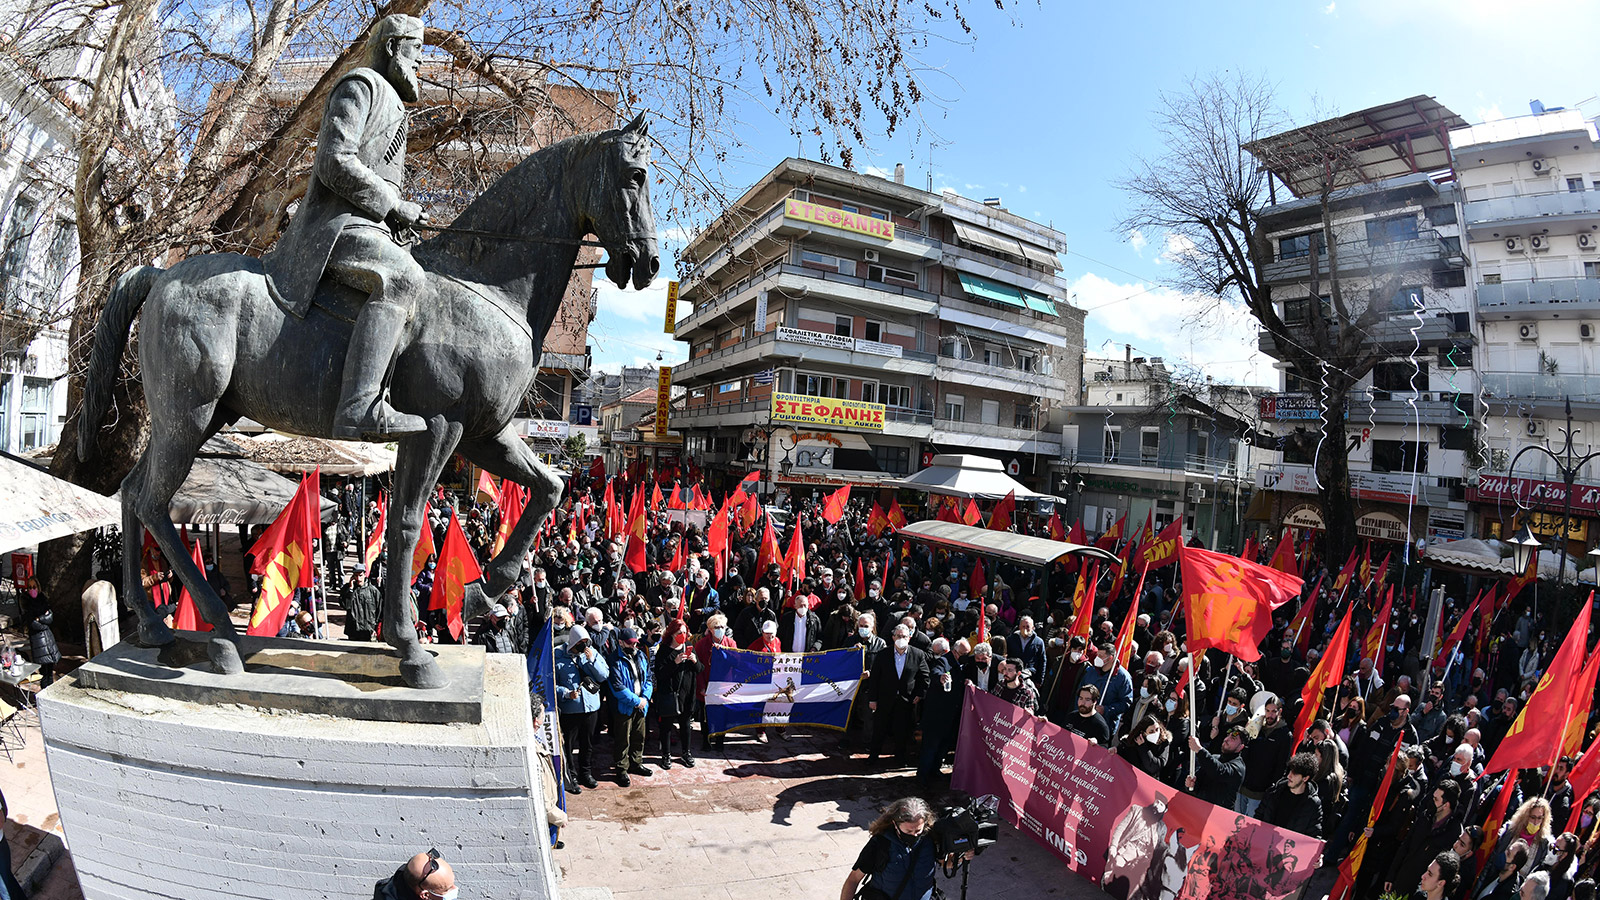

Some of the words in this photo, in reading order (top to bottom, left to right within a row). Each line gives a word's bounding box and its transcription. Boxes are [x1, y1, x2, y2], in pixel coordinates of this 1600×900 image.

[788, 201, 892, 237] ΣΤΕΦΑΝΗΣ
[667, 281, 677, 324] ΣΤΕΦΑΝΗΣ
[779, 327, 822, 339] ΑΣΦΑΛΙΣΤΙΚΑ
[825, 334, 853, 344] ΓΡΑΦΕΙΑ
[657, 368, 670, 434] ΣΤΕΦΑΝΗΣ
[775, 393, 821, 404] ΦΡΟΝΤΙΣΤΗΡΙΑ
[578, 407, 590, 422] P
[775, 400, 883, 423] ΣΤΕΦΑΝΗΣ
[1482, 479, 1524, 495] Hotel
[757, 656, 820, 664] ΠΑΡΑΡΤΗΜΑ
[784, 666, 814, 676] ΕΘΝΙΚΗΣ
